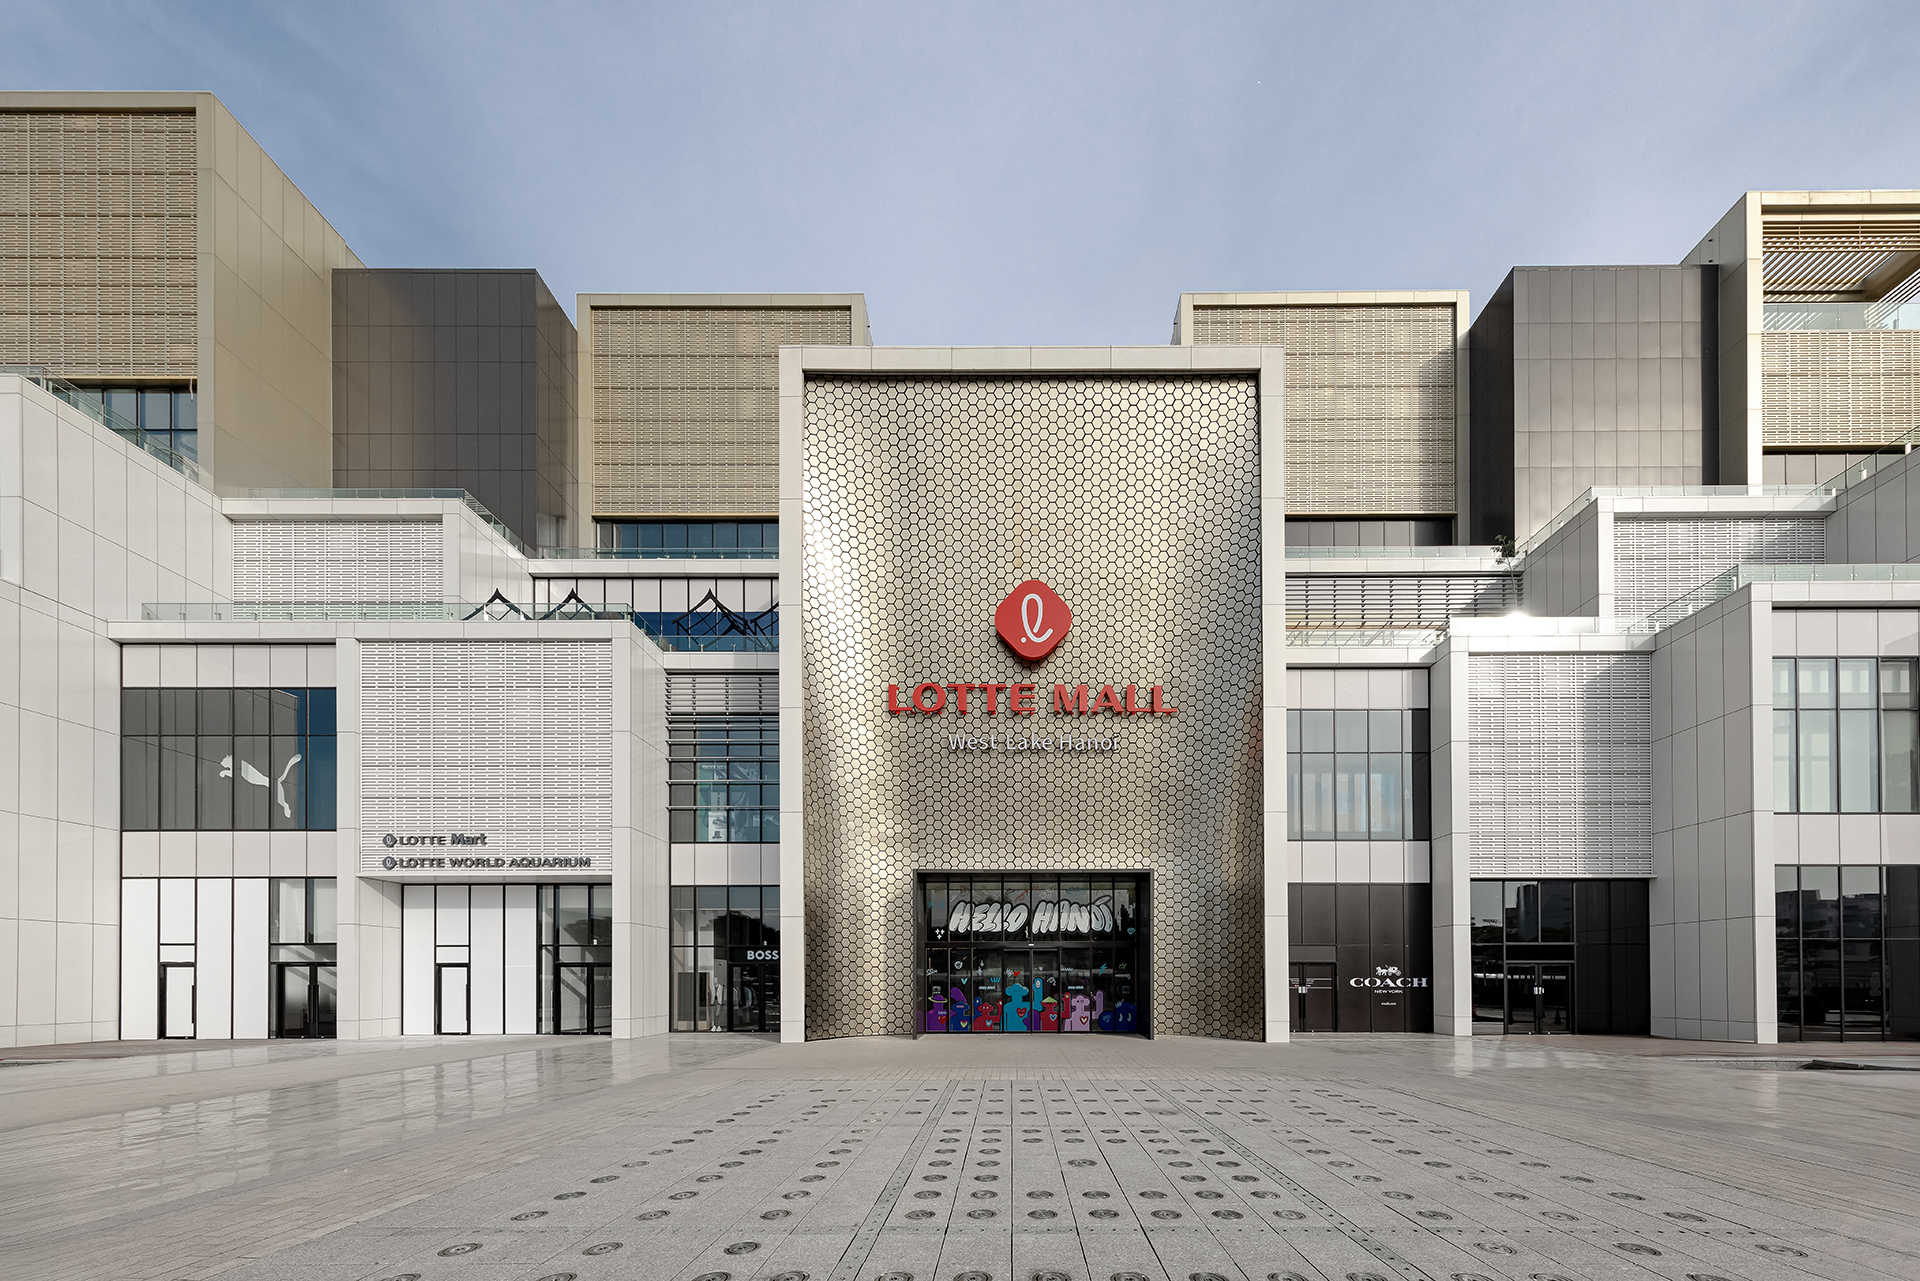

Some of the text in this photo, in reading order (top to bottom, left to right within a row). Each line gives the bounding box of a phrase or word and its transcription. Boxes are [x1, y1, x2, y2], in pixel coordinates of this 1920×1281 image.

[888, 682, 1178, 713] LOTTE MALL
[948, 733, 1120, 751] West Lake Hanoi
[399, 833, 488, 846] LOTTE Mart
[399, 857, 592, 868] LOTTE WORLD AQUARIUM
[747, 950, 780, 960] BOSS
[1349, 977, 1428, 988] COACH
